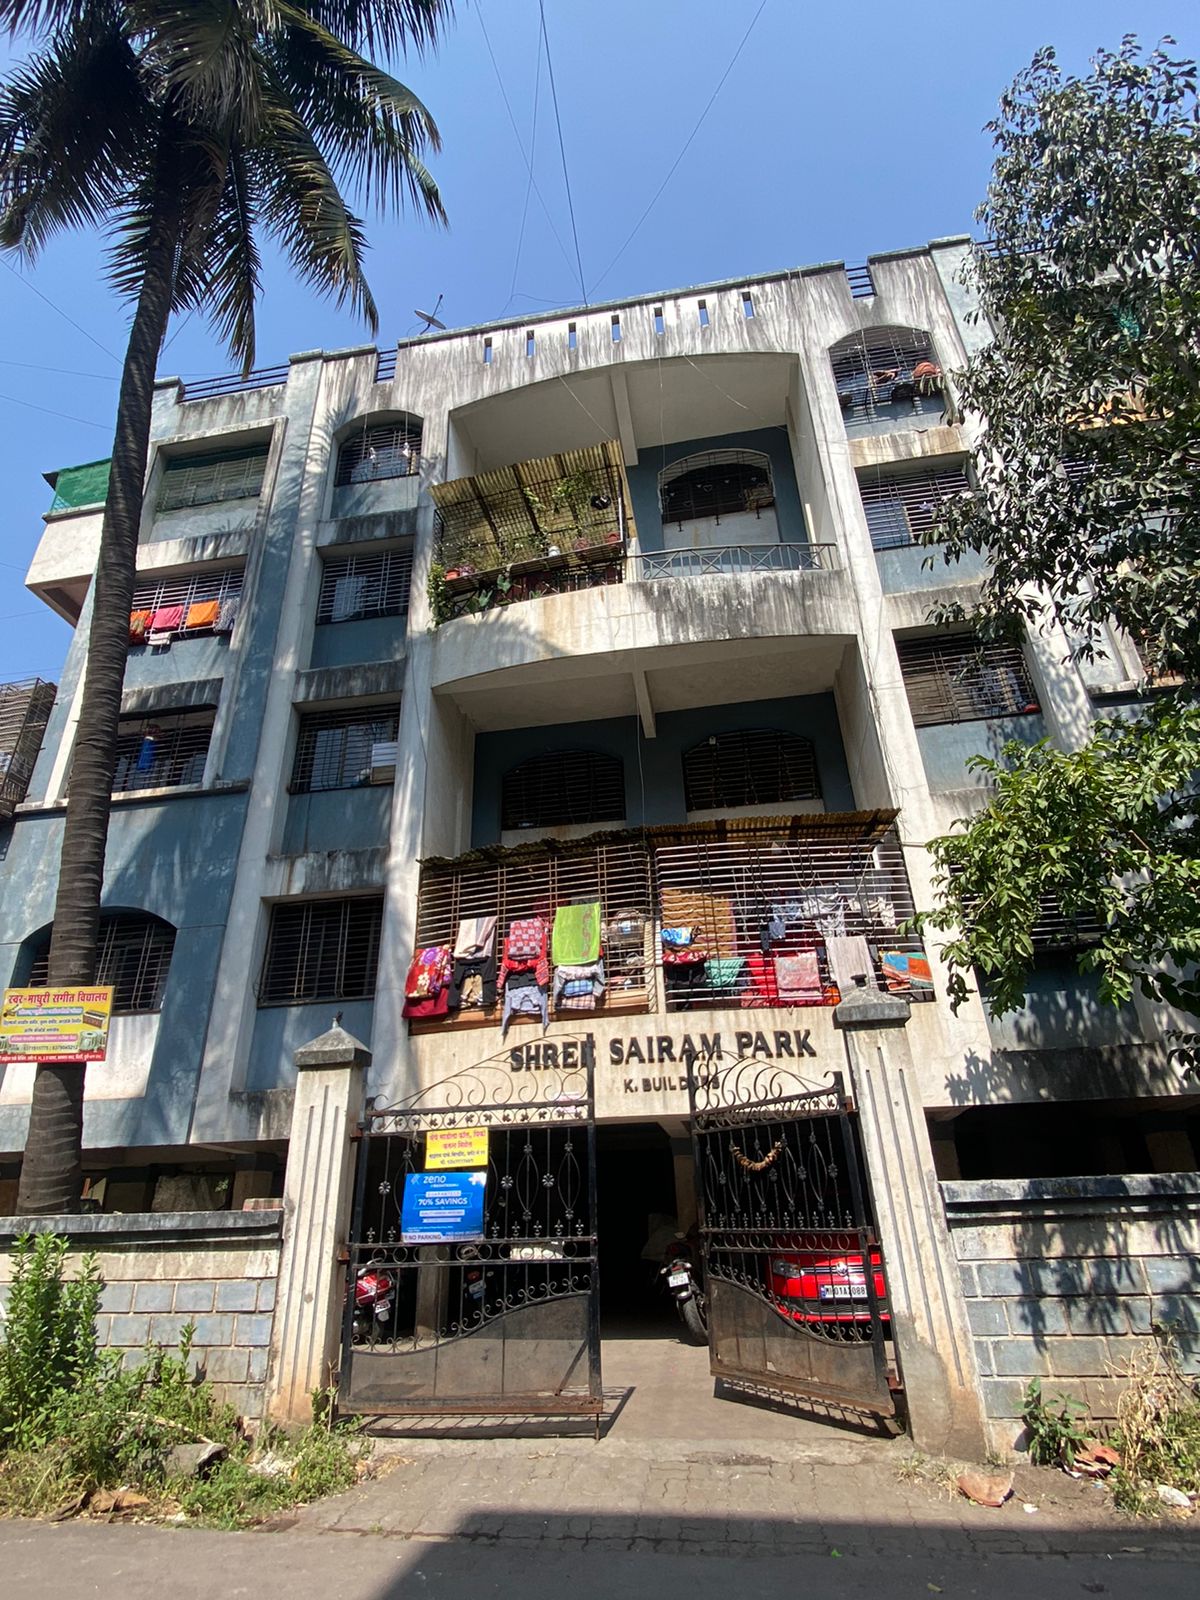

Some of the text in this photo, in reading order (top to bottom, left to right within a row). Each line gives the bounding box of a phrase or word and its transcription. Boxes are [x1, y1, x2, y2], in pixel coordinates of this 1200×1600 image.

[609, 1032, 724, 1066] SAIRAM
[734, 1029, 817, 1060] PARK
[423, 1175, 447, 1184] zeno
[418, 1197, 468, 1206] 70% SAVINGS
[417, 1233, 442, 1241] PARKING
